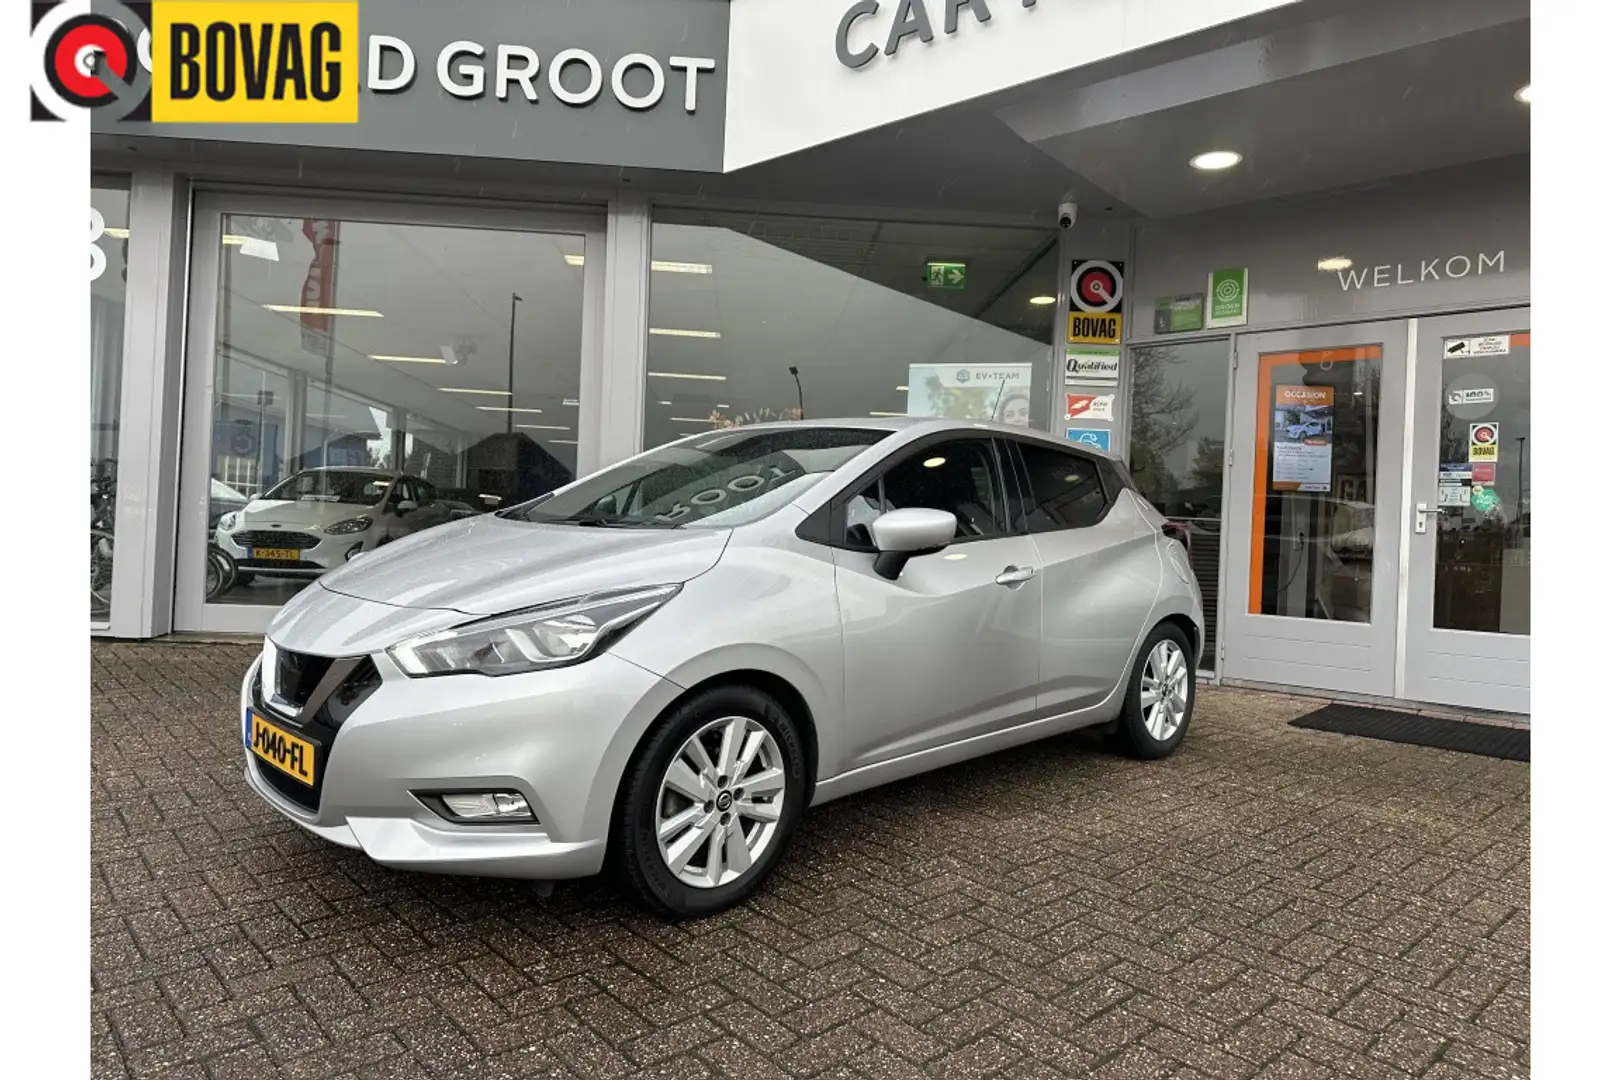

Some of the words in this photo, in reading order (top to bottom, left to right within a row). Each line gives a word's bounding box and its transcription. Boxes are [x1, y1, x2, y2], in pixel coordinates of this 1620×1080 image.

[437, 42, 717, 113] GROOT
[1337, 250, 1505, 291] WELKOM
[1072, 317, 1117, 339] BOVAG
[1066, 359, 1118, 373] Qualified
[253, 721, 308, 778] J-040-FL
